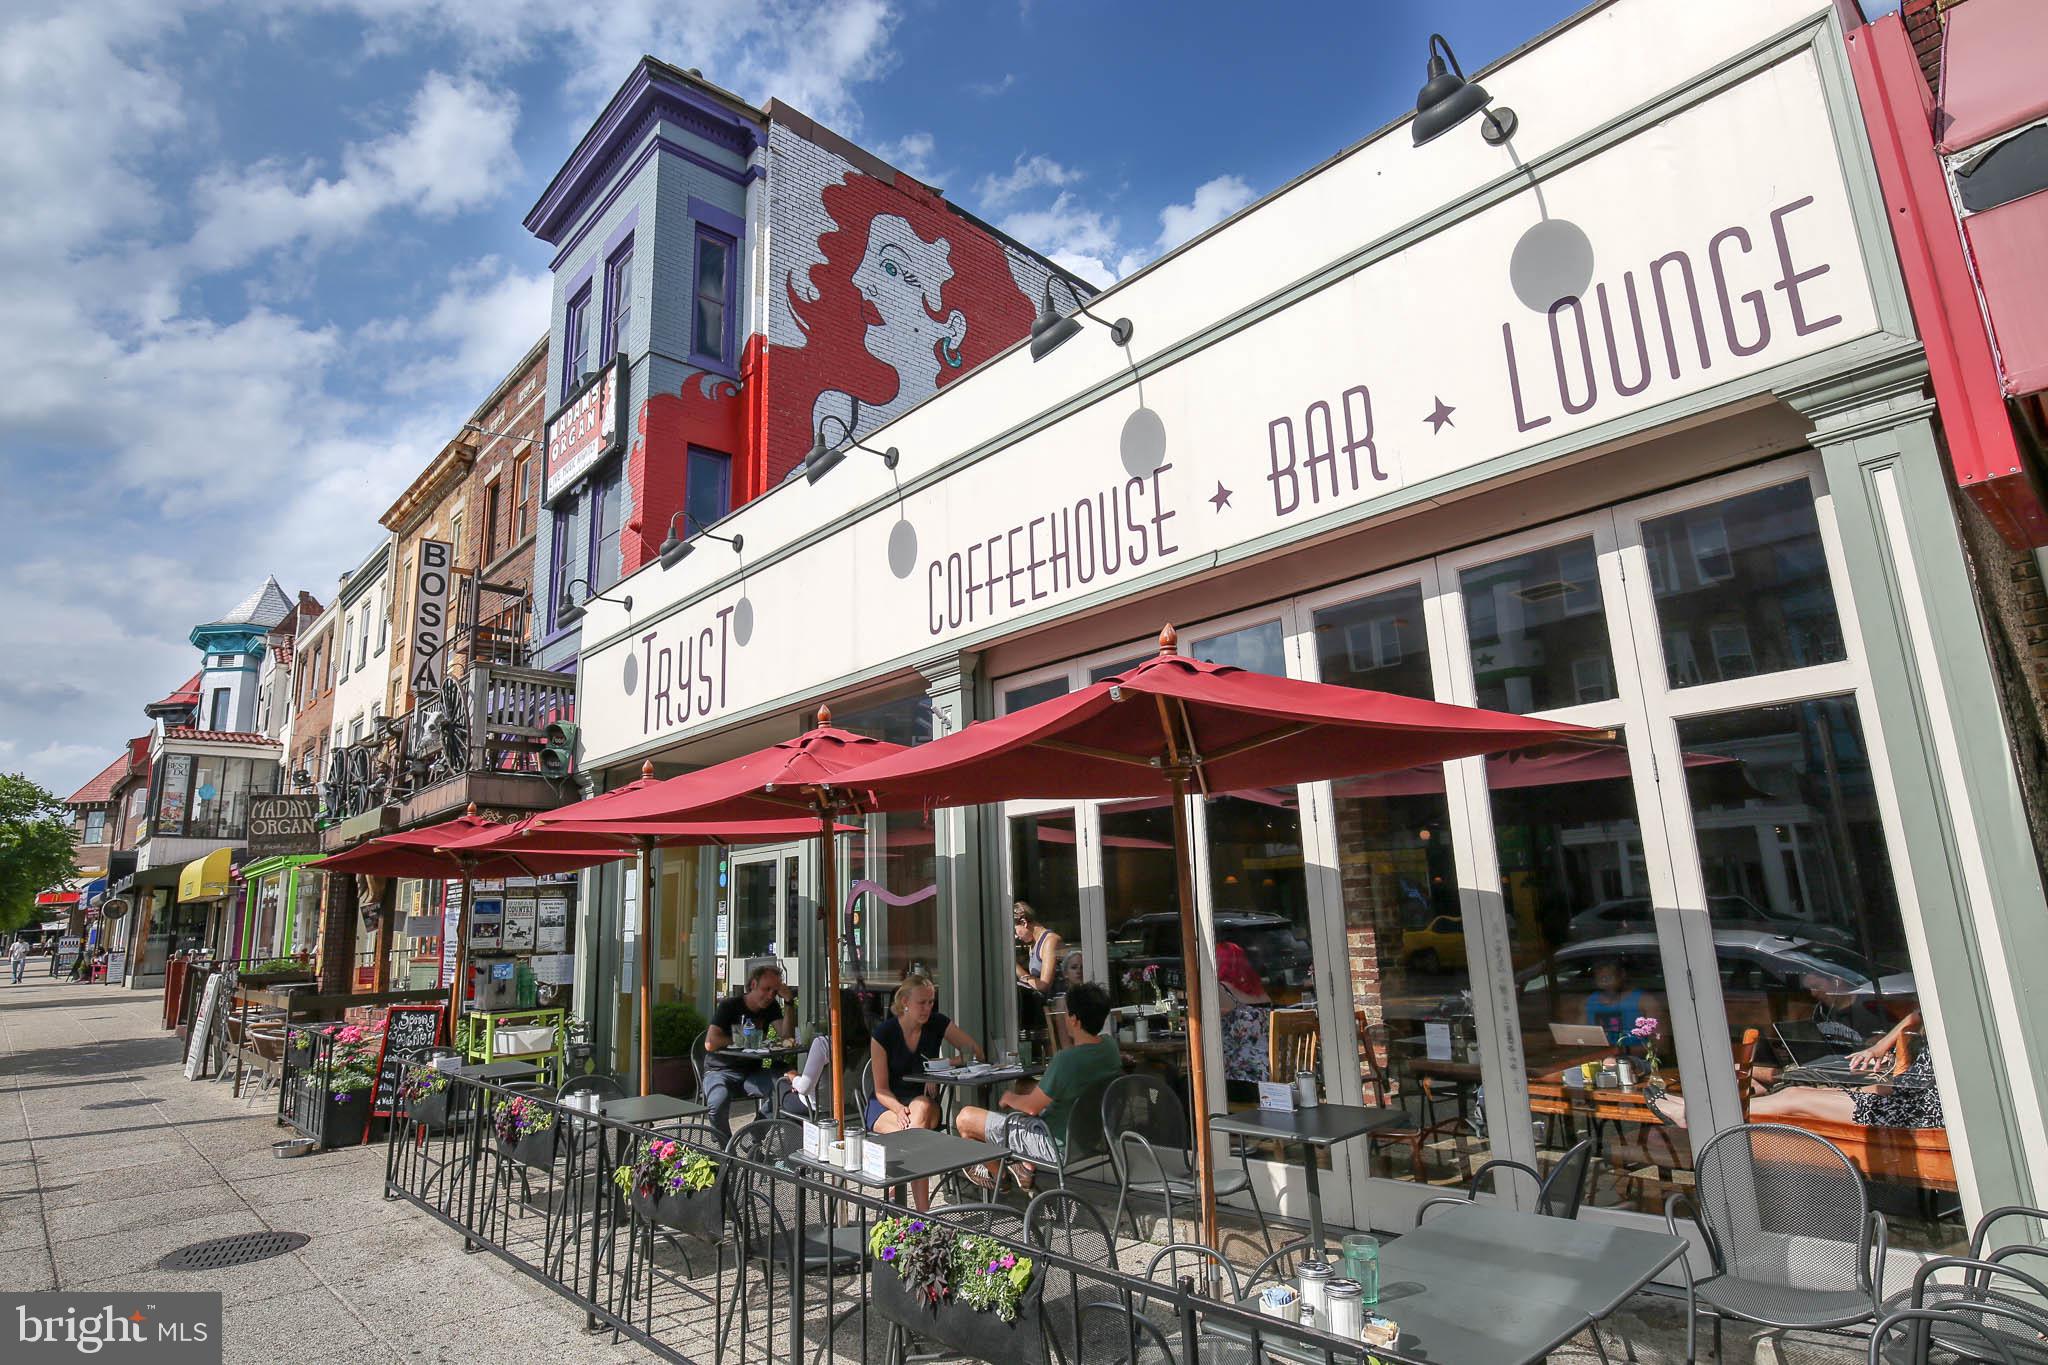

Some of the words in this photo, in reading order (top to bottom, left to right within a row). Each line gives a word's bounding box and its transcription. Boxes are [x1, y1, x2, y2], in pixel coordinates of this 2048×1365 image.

[551, 406, 596, 462] ORGAN
[928, 463, 1179, 635] COFFEEHOUSE
[1267, 384, 1388, 517] BAR
[1502, 195, 1843, 433] LOUNGE
[413, 543, 446, 690] BOSSA
[642, 605, 734, 735] TRYST
[250, 819, 315, 835] ORGAN
[251, 800, 312, 818] MADAM
[399, 1012, 435, 1033] Spring
